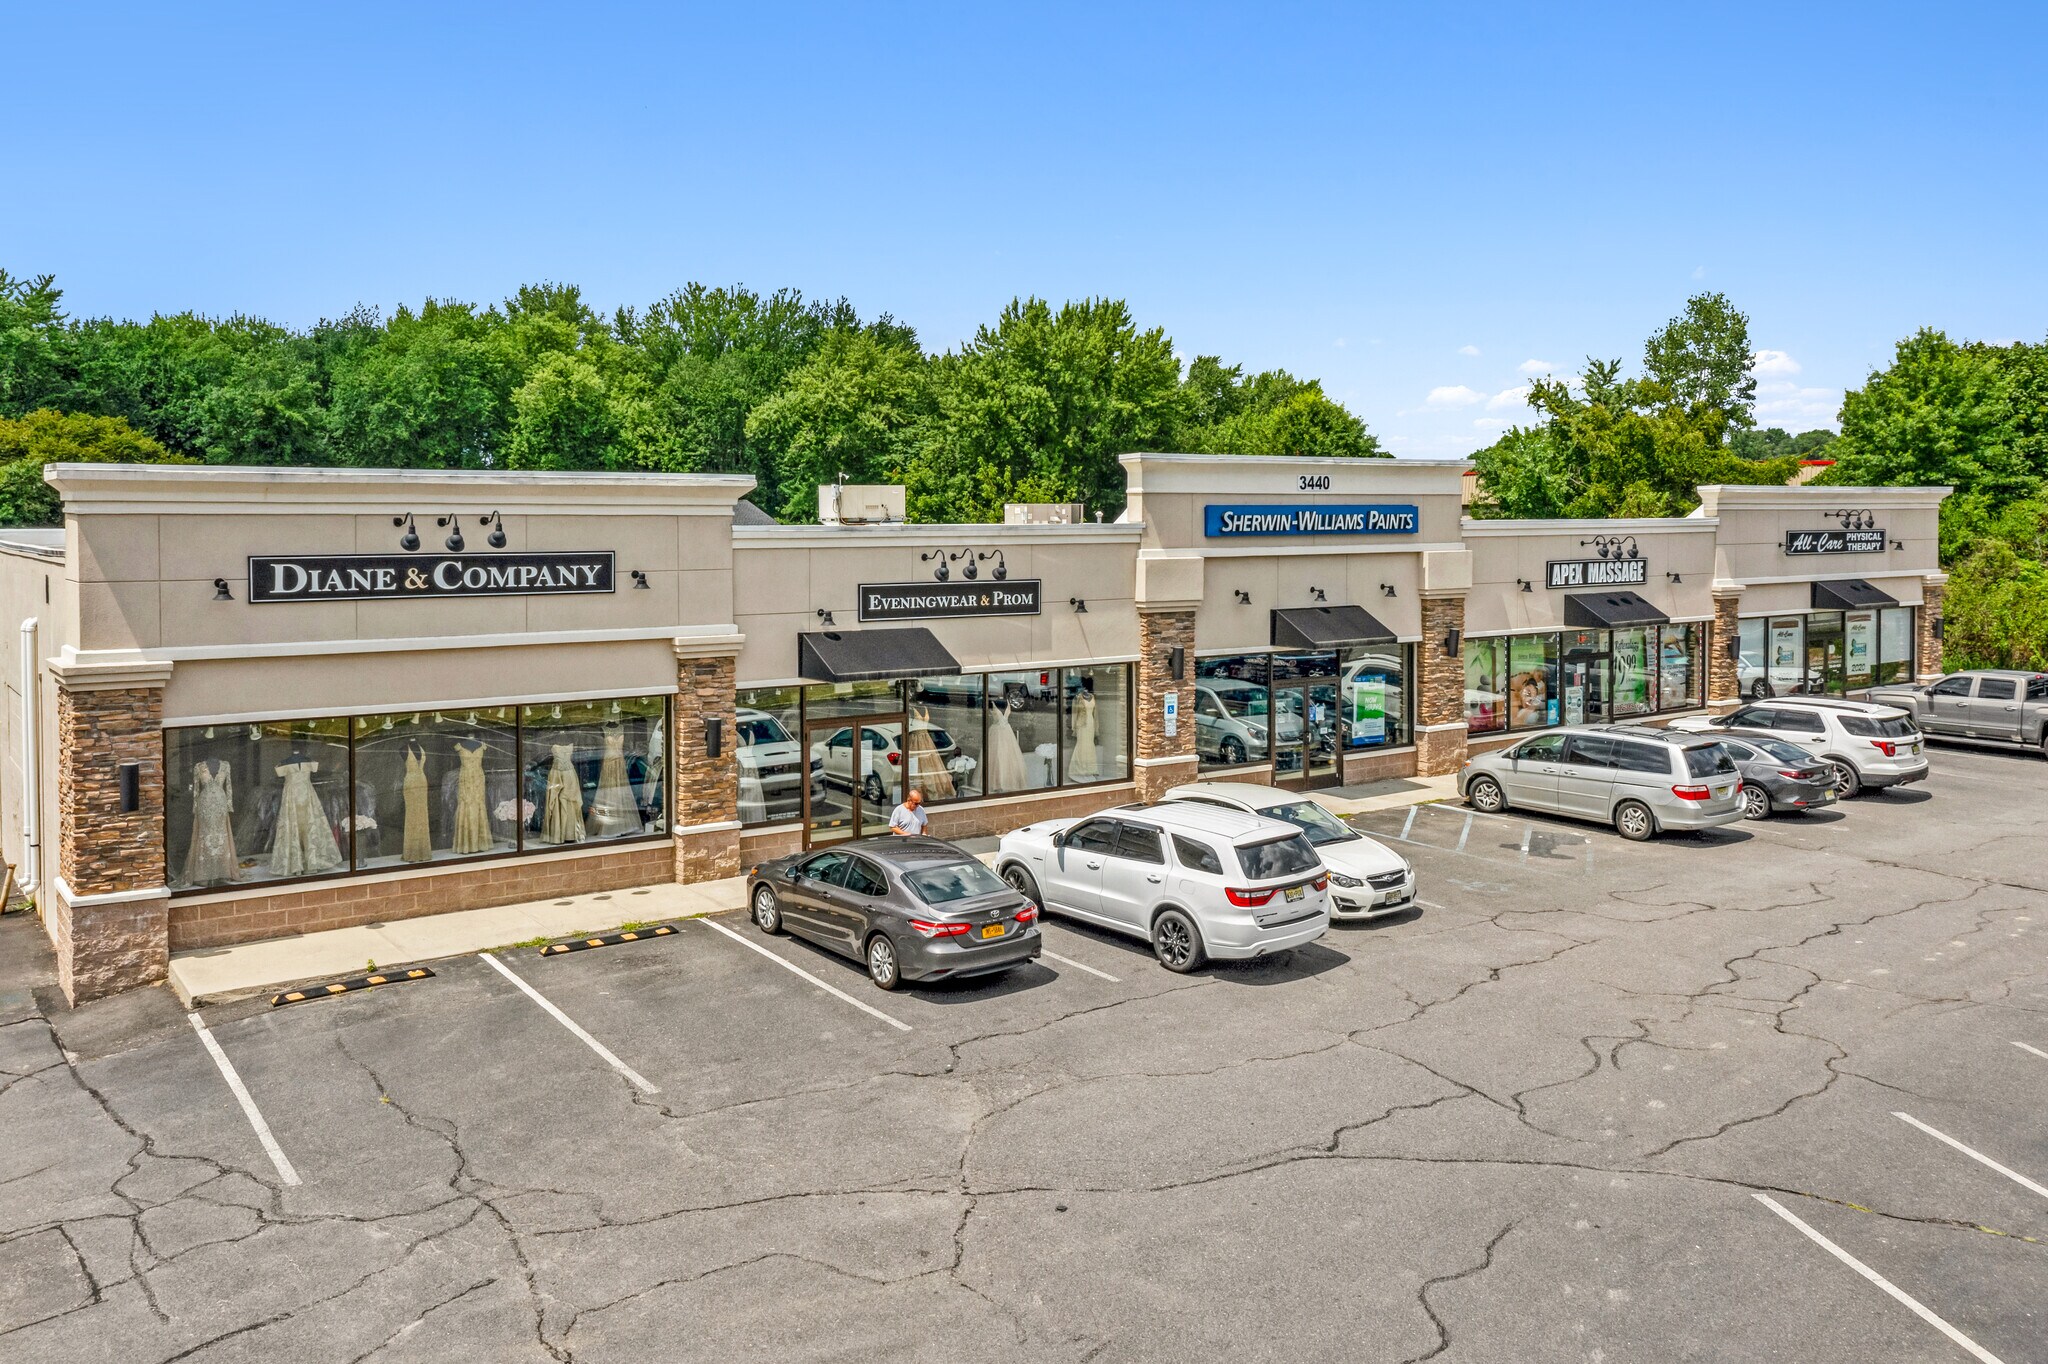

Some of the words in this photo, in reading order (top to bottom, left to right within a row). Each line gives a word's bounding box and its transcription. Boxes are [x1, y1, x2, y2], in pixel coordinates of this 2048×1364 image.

[1299, 475, 1330, 490] 3440
[1222, 510, 1364, 532] SHERWIN-WILLIAMS
[1368, 510, 1414, 530] PAINTS
[1791, 533, 1843, 552] All-Care
[1846, 532, 1882, 541] PHYSICAL
[1847, 542, 1881, 551] THERAPY
[269, 563, 397, 593] DIANE
[404, 567, 428, 589] &
[433, 561, 602, 590] COMPANY
[1551, 563, 1583, 585] APEX
[1587, 561, 1644, 583] MASSAGE
[868, 594, 977, 610] EVENINGWEAR
[980, 595, 990, 608] &
[993, 590, 1034, 606] PROM
